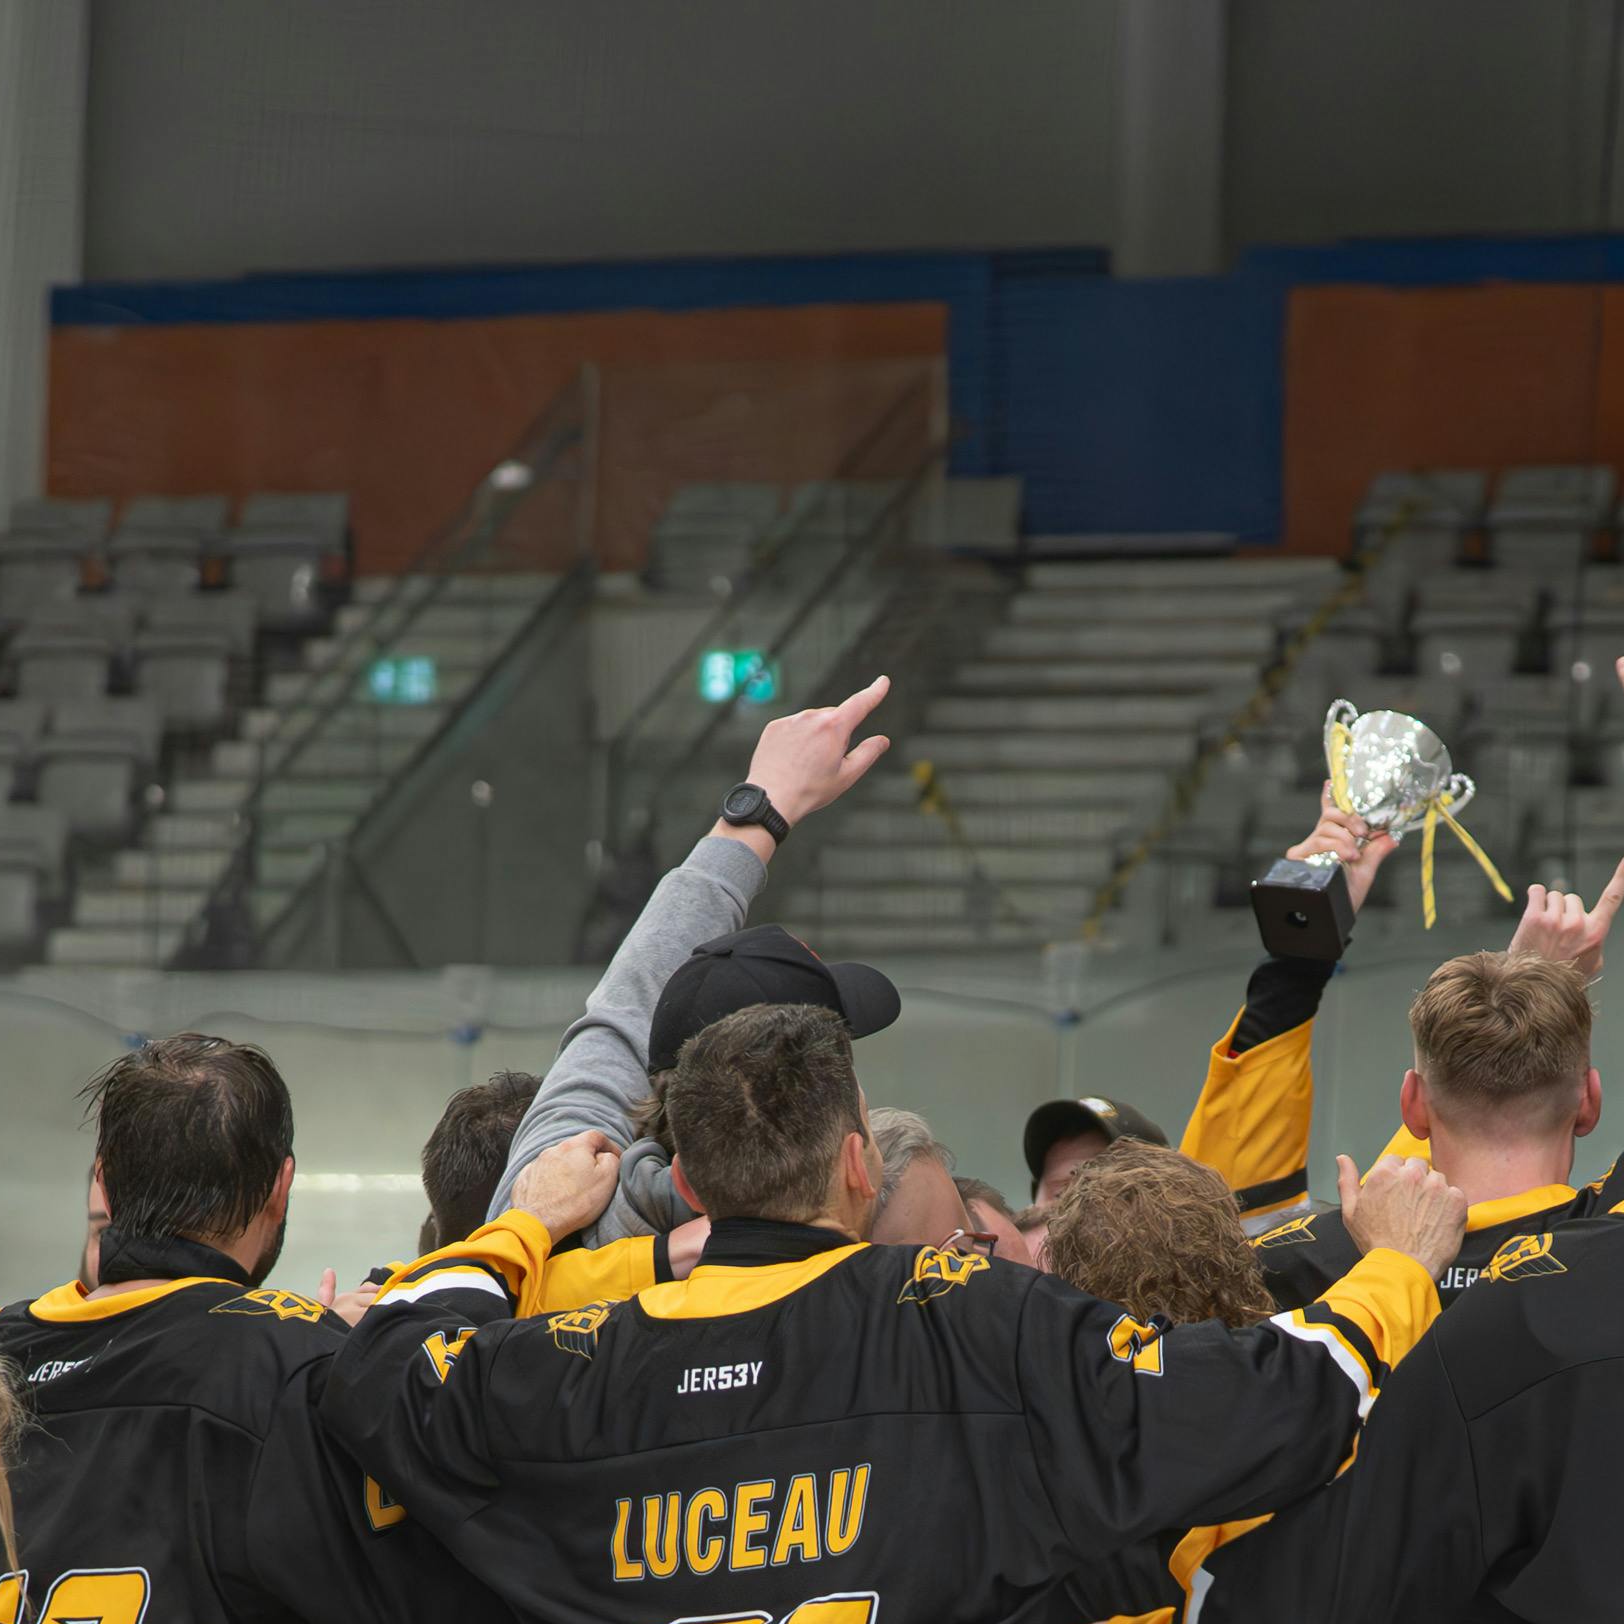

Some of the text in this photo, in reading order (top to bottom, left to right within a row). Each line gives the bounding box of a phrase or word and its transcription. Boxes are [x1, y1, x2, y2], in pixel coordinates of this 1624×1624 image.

[1439, 1266, 1480, 1290] JER
[677, 1361, 763, 1394] JER53Y
[612, 1463, 872, 1582] LUCEAU
